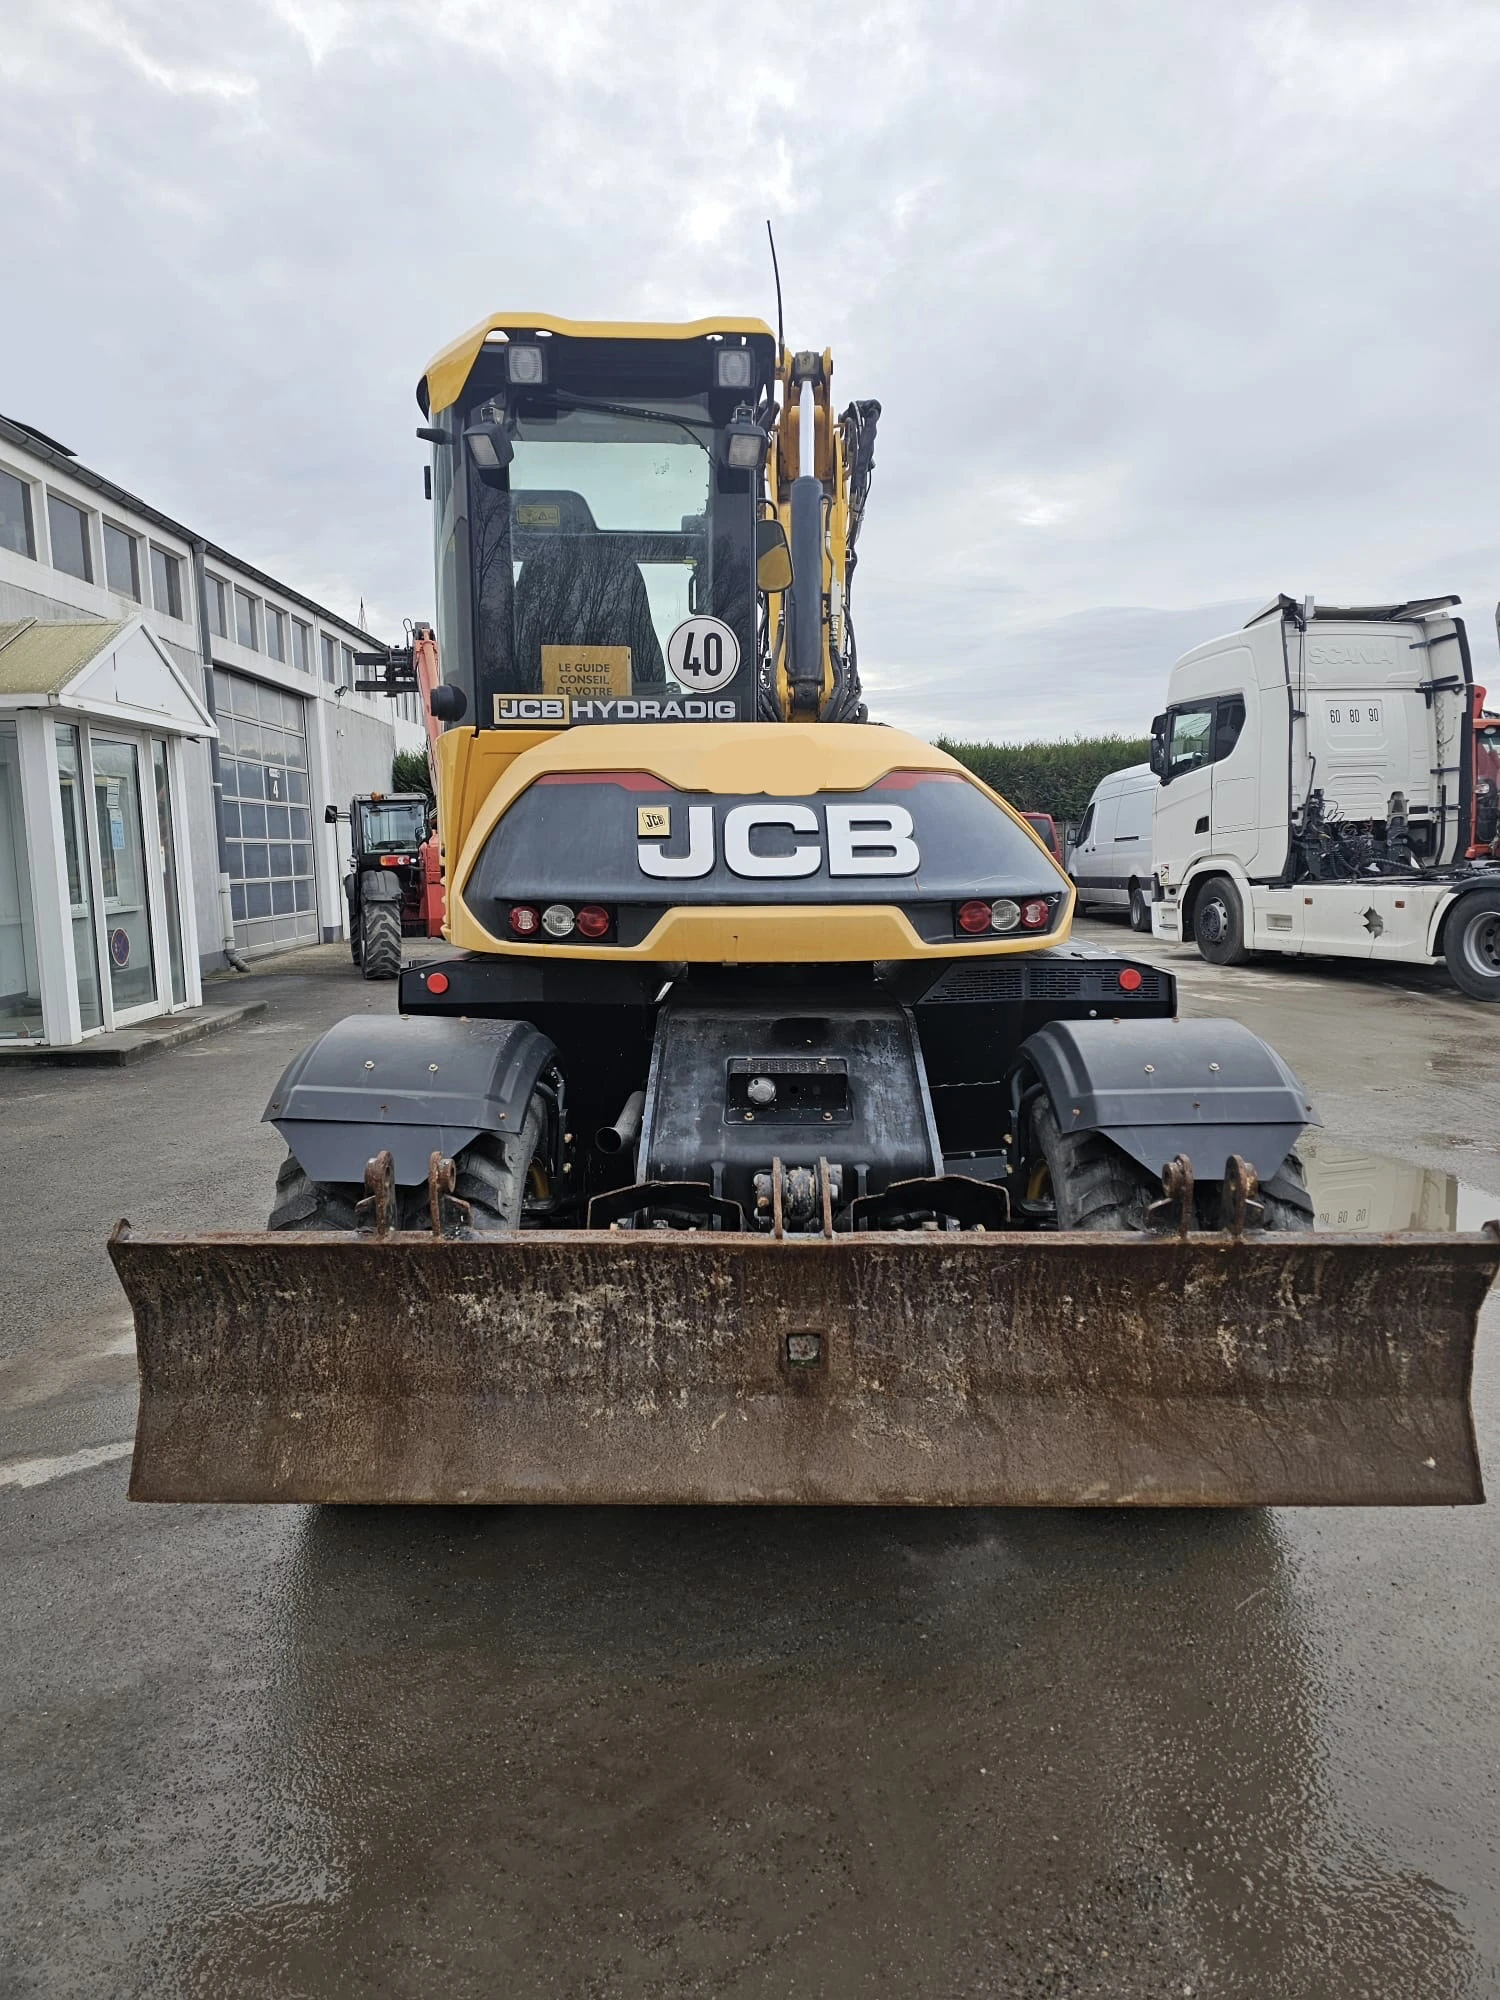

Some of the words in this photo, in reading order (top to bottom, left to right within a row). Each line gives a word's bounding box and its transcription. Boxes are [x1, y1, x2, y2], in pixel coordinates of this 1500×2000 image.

[682, 631, 723, 677] 40
[1308, 647, 1394, 665] SCANIA
[558, 663, 571, 673] LE
[574, 663, 610, 673] GUIDE
[560, 675, 610, 685] CONSEIL
[557, 686, 571, 696] DE
[575, 686, 613, 696] VOTRE
[500, 700, 563, 718] JCB
[572, 701, 735, 719] HYDRADIG
[1329, 709, 1341, 723] 60
[1349, 709, 1360, 723] 80
[1368, 708, 1379, 721] 90
[273, 780, 279, 799] 4
[638, 804, 921, 879] JCB
